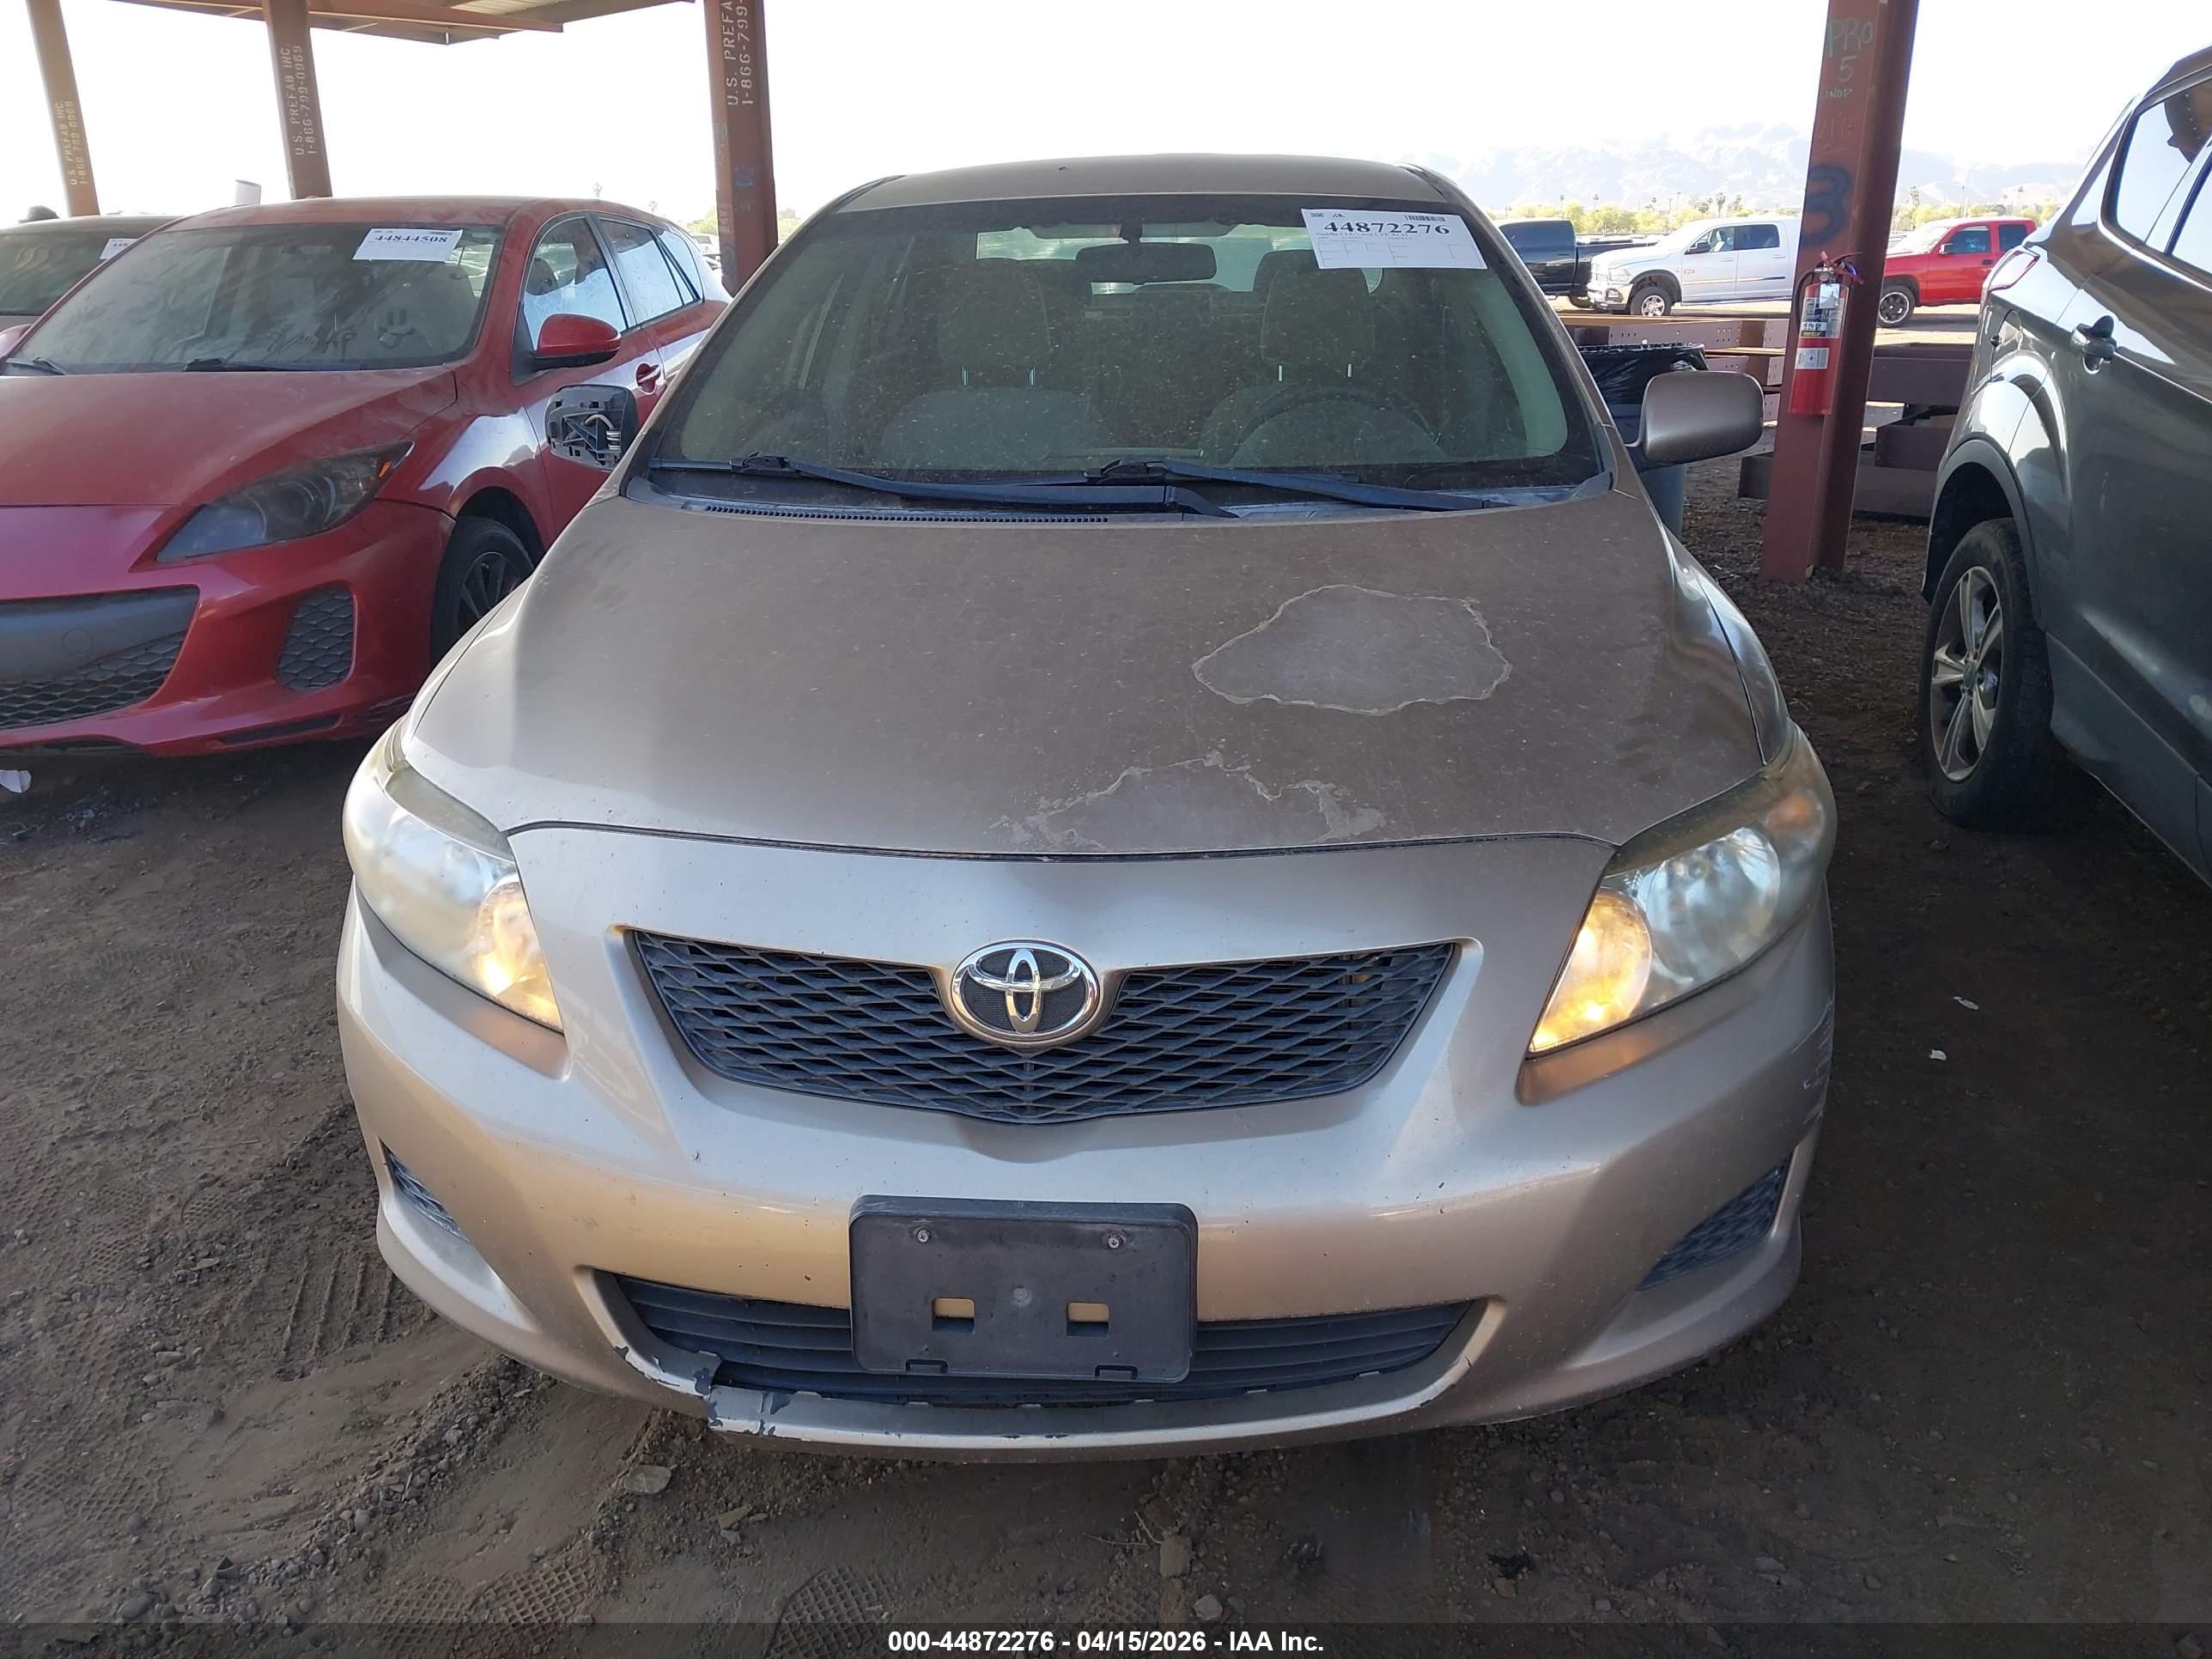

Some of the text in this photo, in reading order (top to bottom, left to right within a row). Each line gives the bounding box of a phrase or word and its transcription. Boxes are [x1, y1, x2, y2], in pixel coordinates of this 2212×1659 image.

[280, 43, 293, 69] INC.
[1838, 55, 1856, 82] 5
[284, 75, 301, 125] PREFAB
[726, 72, 738, 106] U.S.
[374, 234, 447, 243] 44844508
[1324, 222, 1449, 234] 44872276
